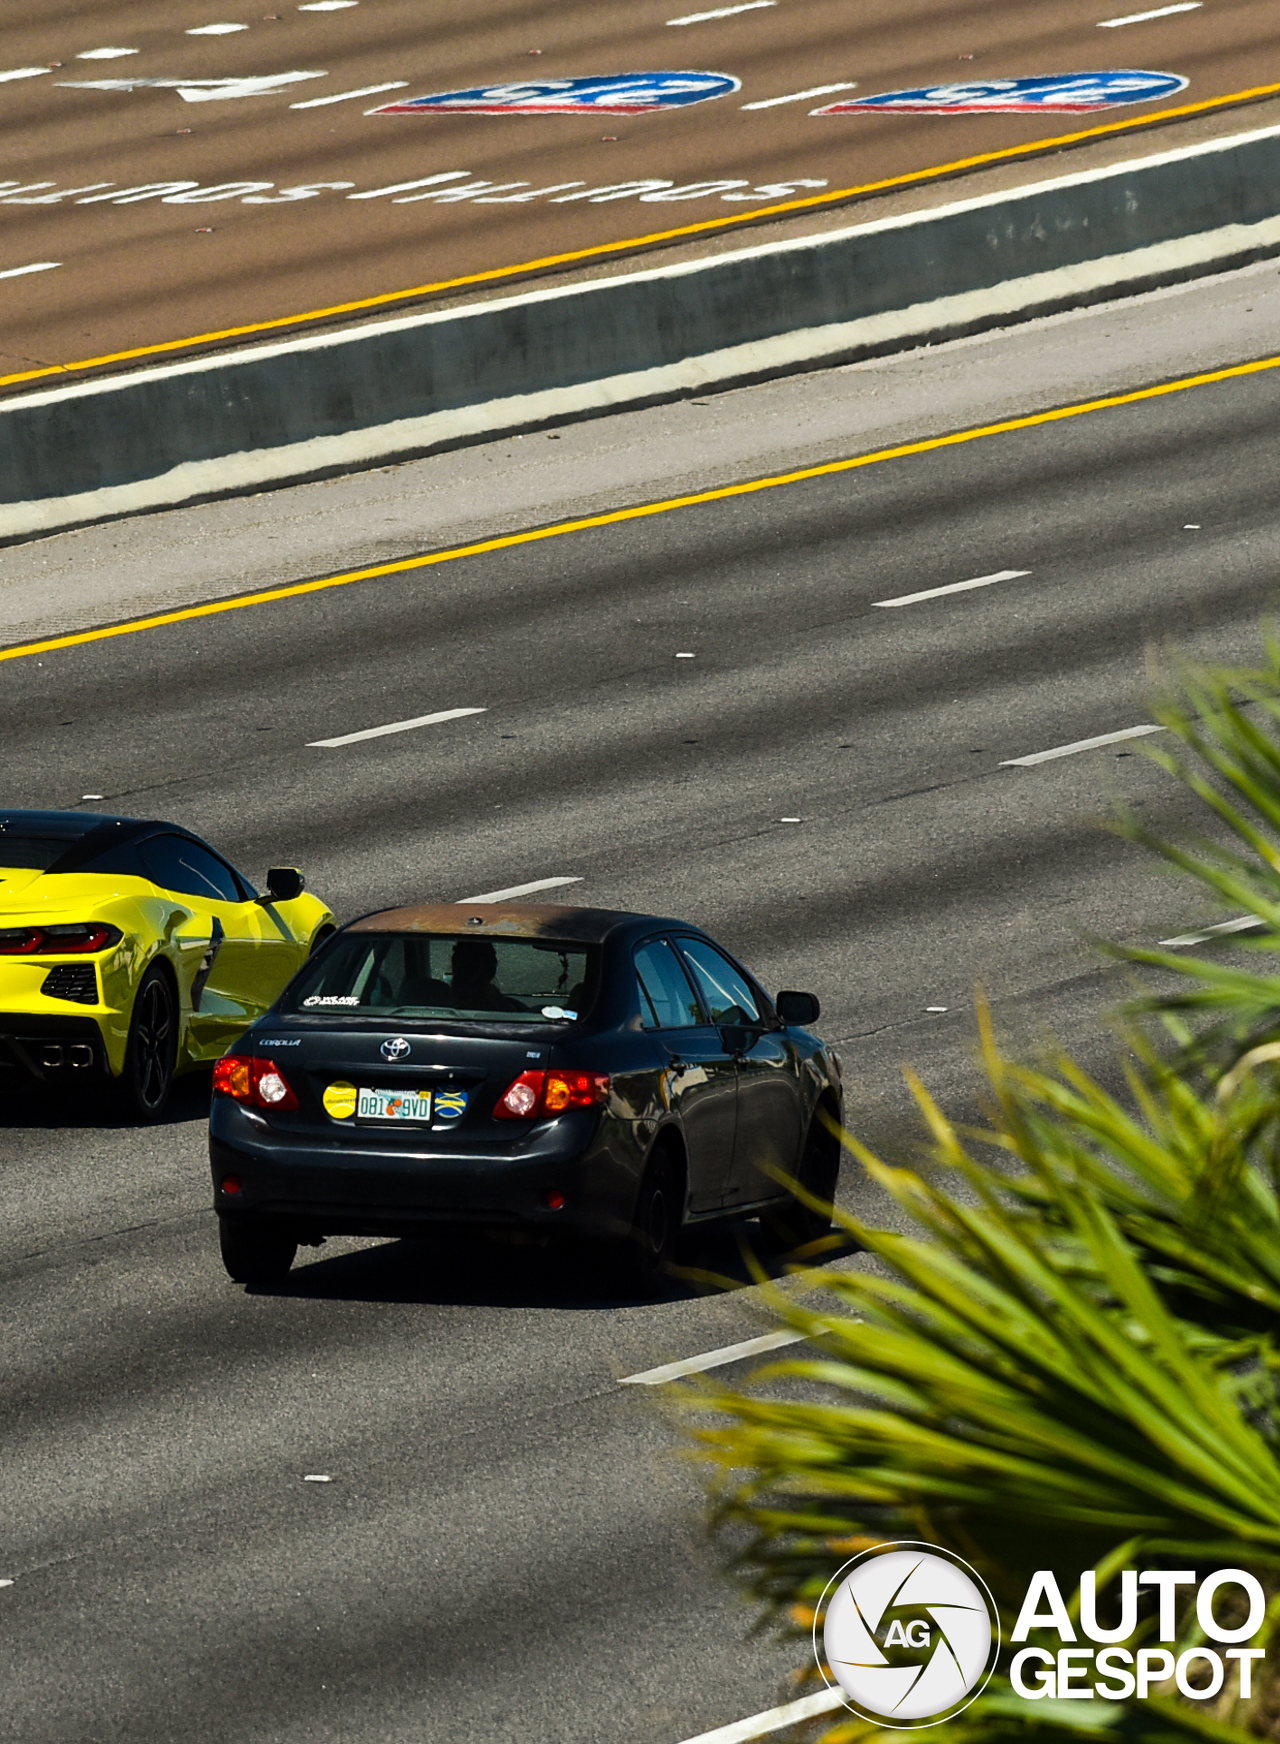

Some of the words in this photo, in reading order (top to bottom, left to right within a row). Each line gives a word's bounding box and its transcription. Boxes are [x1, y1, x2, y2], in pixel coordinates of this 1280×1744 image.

[441, 80, 727, 104] 275
[884, 78, 1173, 104] 275
[392, 179, 829, 203] SOUTH
